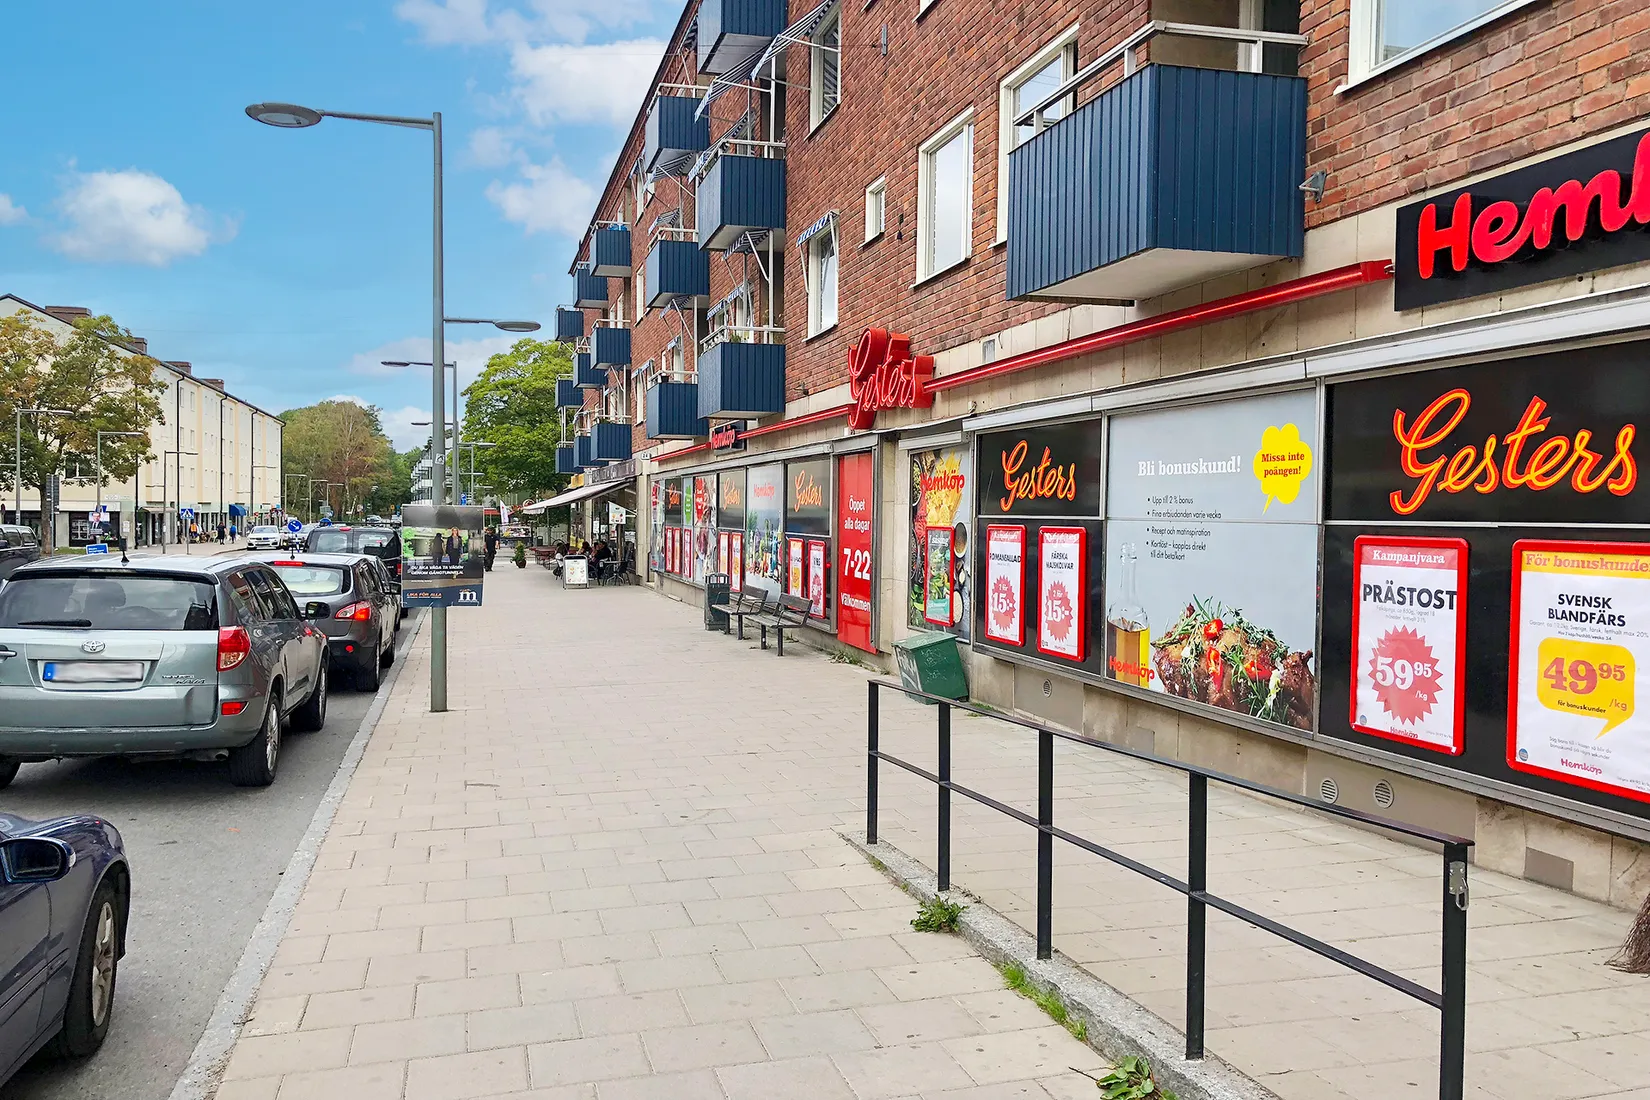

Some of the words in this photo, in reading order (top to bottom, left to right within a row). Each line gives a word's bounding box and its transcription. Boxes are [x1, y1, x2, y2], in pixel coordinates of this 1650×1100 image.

[847, 328, 925, 429] Gesters
[1261, 453, 1285, 462] Missa
[1288, 452, 1304, 461] inte
[1389, 388, 1638, 515] Gesters
[1138, 460, 1155, 476] Bli
[1158, 455, 1241, 476] bonuskund!
[1264, 466, 1301, 478] poängen!
[1000, 440, 1077, 512] Gesters
[794, 470, 822, 512] Gesters
[849, 495, 865, 513] Öppet
[1152, 496, 1162, 506] Upp
[1179, 495, 1194, 504] bonus
[1193, 510, 1206, 519] varje
[1207, 510, 1221, 519] vecka
[844, 517, 854, 529] alla
[854, 518, 870, 533] dagar
[1151, 526, 1166, 536] Recept
[1167, 526, 1175, 535] och
[1176, 528, 1211, 538] matinspiration
[1192, 541, 1206, 550] direkt
[843, 548, 870, 580] 7-22
[1372, 550, 1445, 565] Kampanjvara
[1525, 553, 1550, 566] För
[1553, 555, 1650, 572] bonuskunde
[841, 592, 871, 612] Välkommen
[1363, 580, 1457, 610] PRÄSTOST
[1558, 593, 1612, 609] SVENSK
[1548, 607, 1626, 627] BLANDFÄRS
[1109, 655, 1155, 682] Hemköp
[1415, 690, 1428, 701] /kg
[1566, 701, 1606, 714] bonuskunder
[1609, 698, 1627, 712] /kg
[1560, 758, 1602, 775] Hemköp
